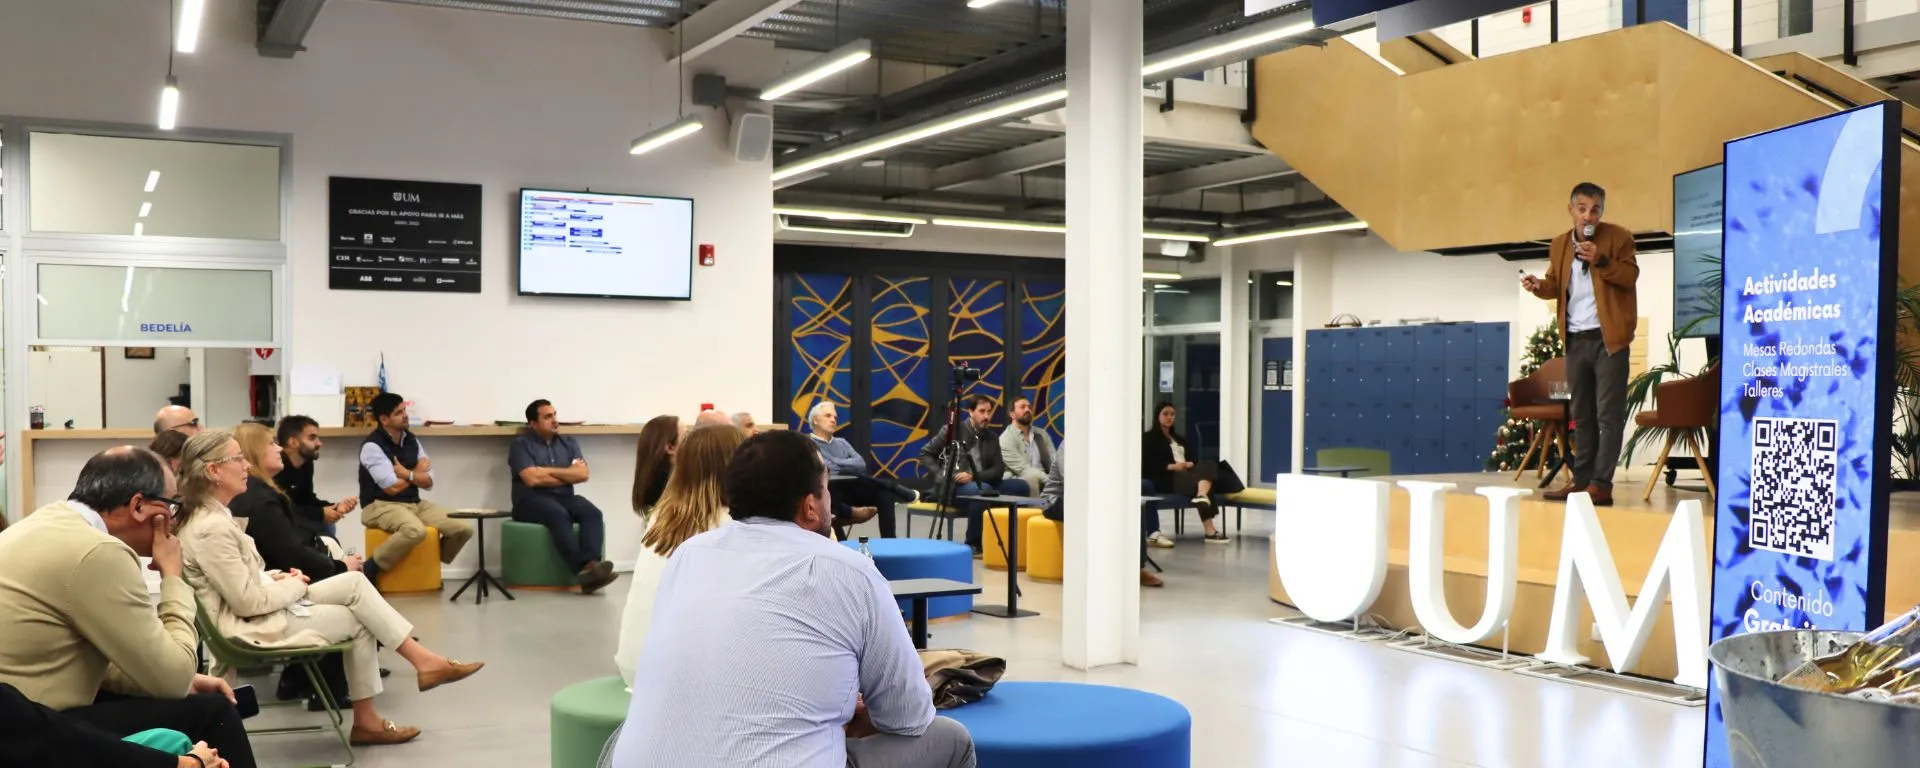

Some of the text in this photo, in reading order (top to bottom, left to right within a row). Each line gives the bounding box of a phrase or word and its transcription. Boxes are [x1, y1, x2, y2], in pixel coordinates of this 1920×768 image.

[403, 193, 420, 203] UM
[1743, 266, 1837, 296] Actividades
[1743, 298, 1841, 324] Académicas
[140, 321, 192, 333] BEDELÍA
[1743, 336, 1836, 357] Mesas Redondas
[1743, 358, 1848, 382] Clases Magistrales
[1743, 379, 1784, 398] Talleres
[1751, 580, 1833, 617] Contenido
